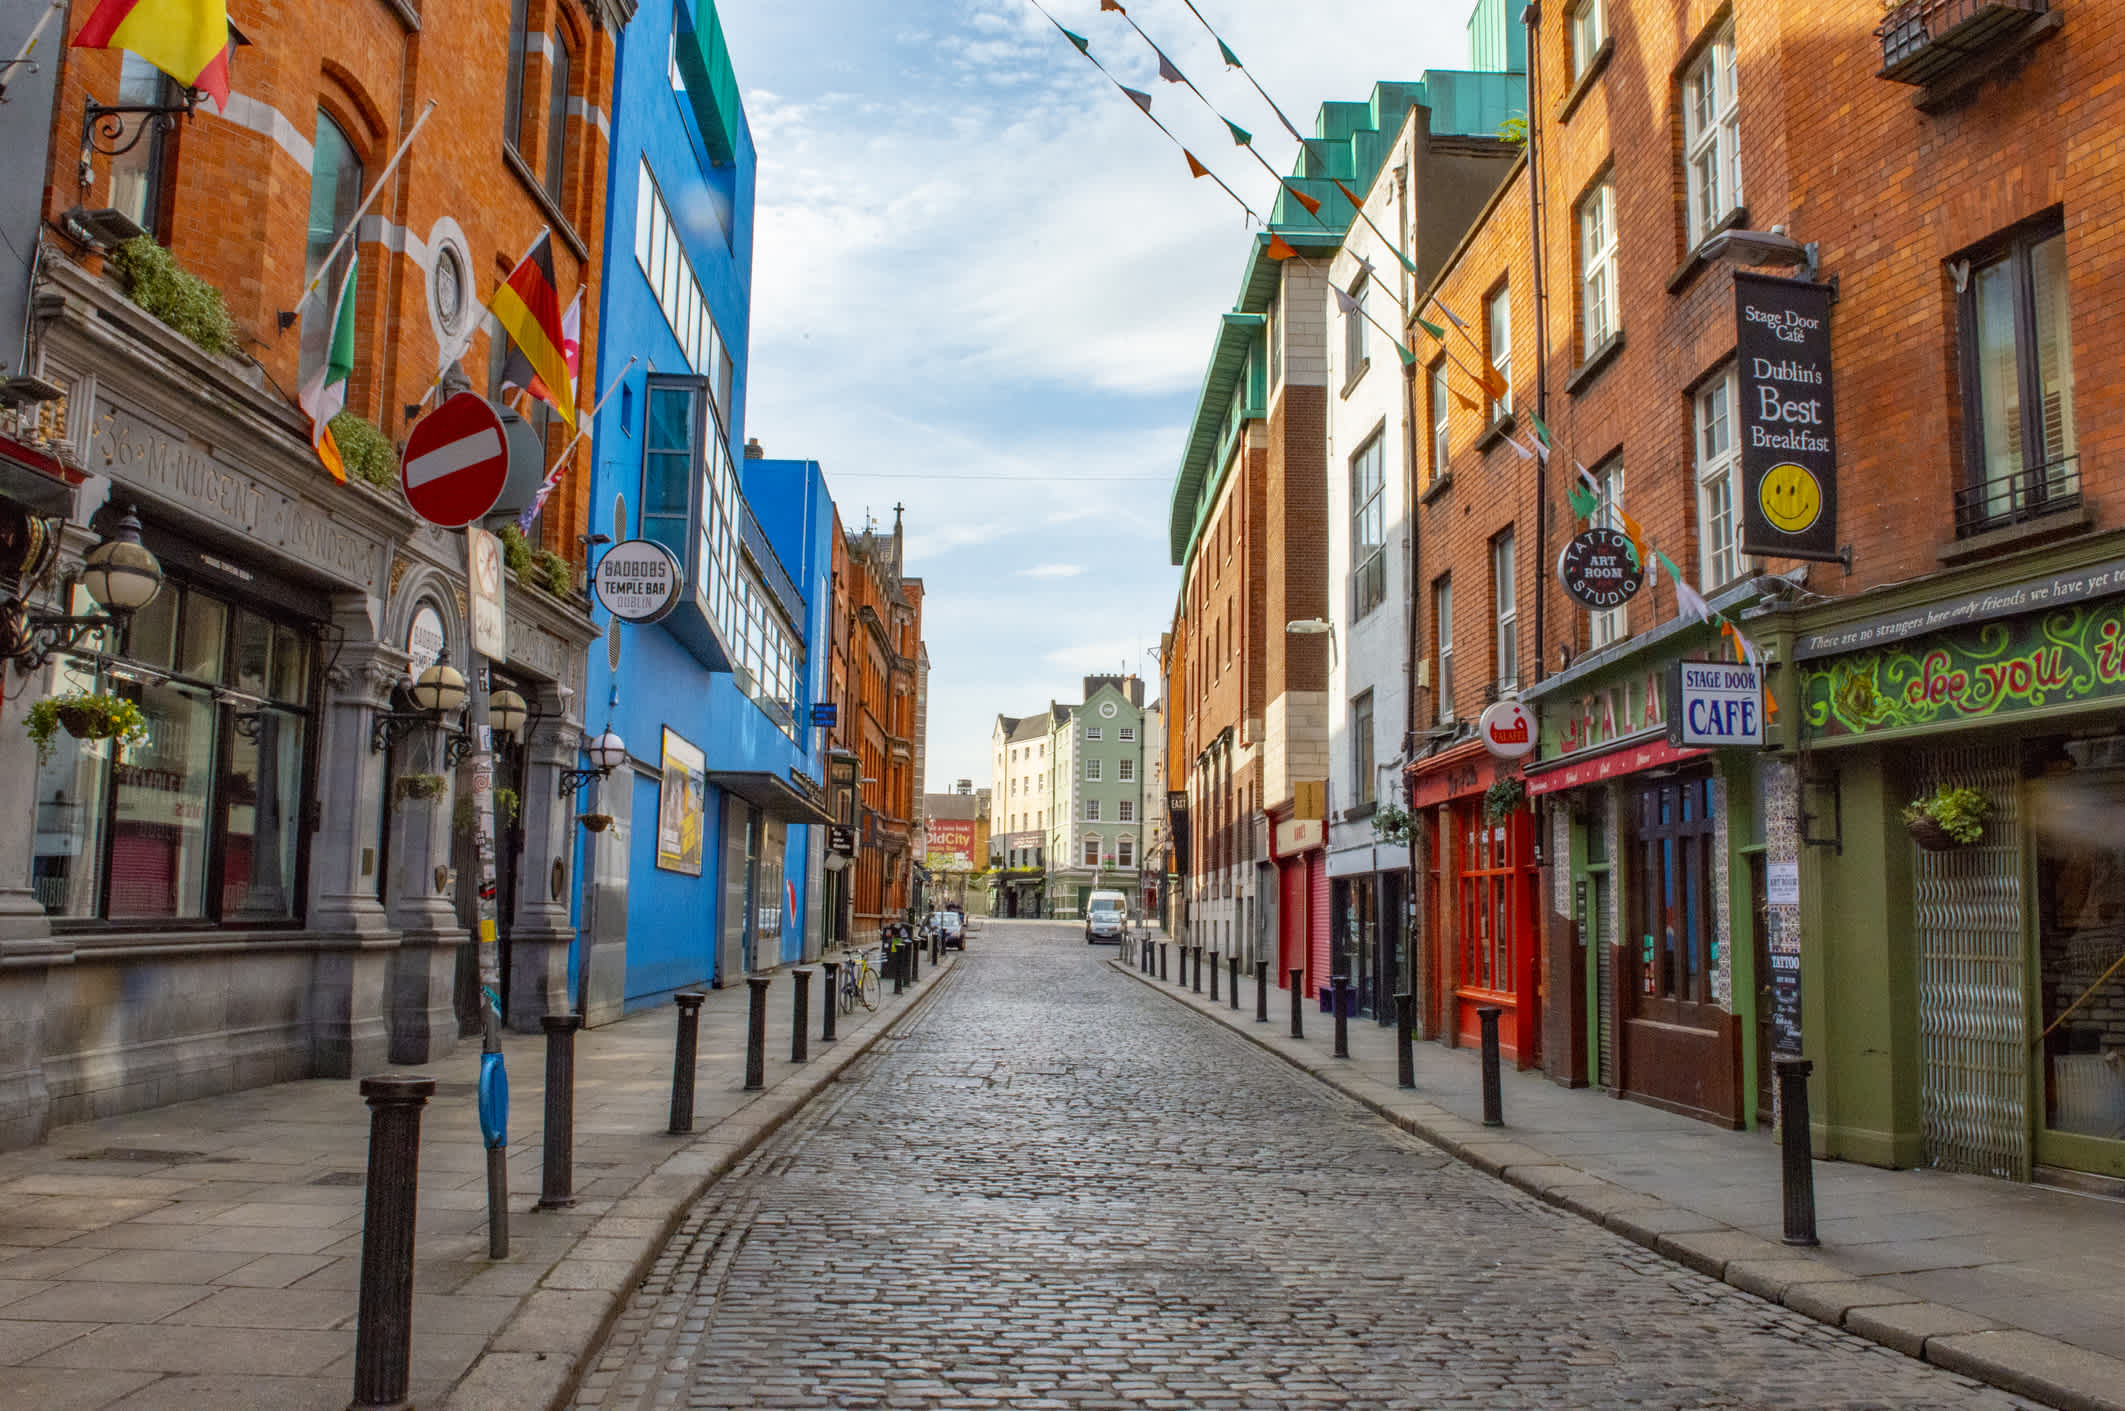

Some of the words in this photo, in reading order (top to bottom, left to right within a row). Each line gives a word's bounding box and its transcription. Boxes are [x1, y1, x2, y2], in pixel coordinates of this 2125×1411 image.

[1745, 306, 1782, 329] Stage
[1785, 311, 1819, 329] Door
[1775, 325, 1805, 343] Café
[1753, 358, 1822, 384] Dublin's
[1757, 385, 1822, 425] Best
[1752, 426, 1830, 452] Breakfast
[1590, 556, 1616, 566] ART
[1584, 568, 1623, 578] ROOM
[605, 582, 643, 595] TEMPLE
[646, 582, 666, 595] BAR
[1573, 580, 1636, 604] STUDIO
[1810, 635, 1838, 650] There
[1841, 631, 1856, 644] are
[1860, 628, 1872, 641] no
[1876, 617, 1923, 636] strangers
[1925, 610, 1950, 625] here
[1952, 599, 1979, 618] only
[1981, 589, 2027, 611] friends
[2030, 587, 2049, 600] we
[2053, 580, 2083, 597] have
[2086, 573, 2110, 594] yet
[1686, 671, 1721, 688] STAGE
[1904, 649, 1969, 705] See
[1958, 647, 2071, 714] you
[1688, 696, 1757, 736] CAFÉ
[1494, 730, 1527, 743] FALAFEL
[1171, 799, 1186, 809] EAST
[1771, 955, 1800, 969] TATTOO
